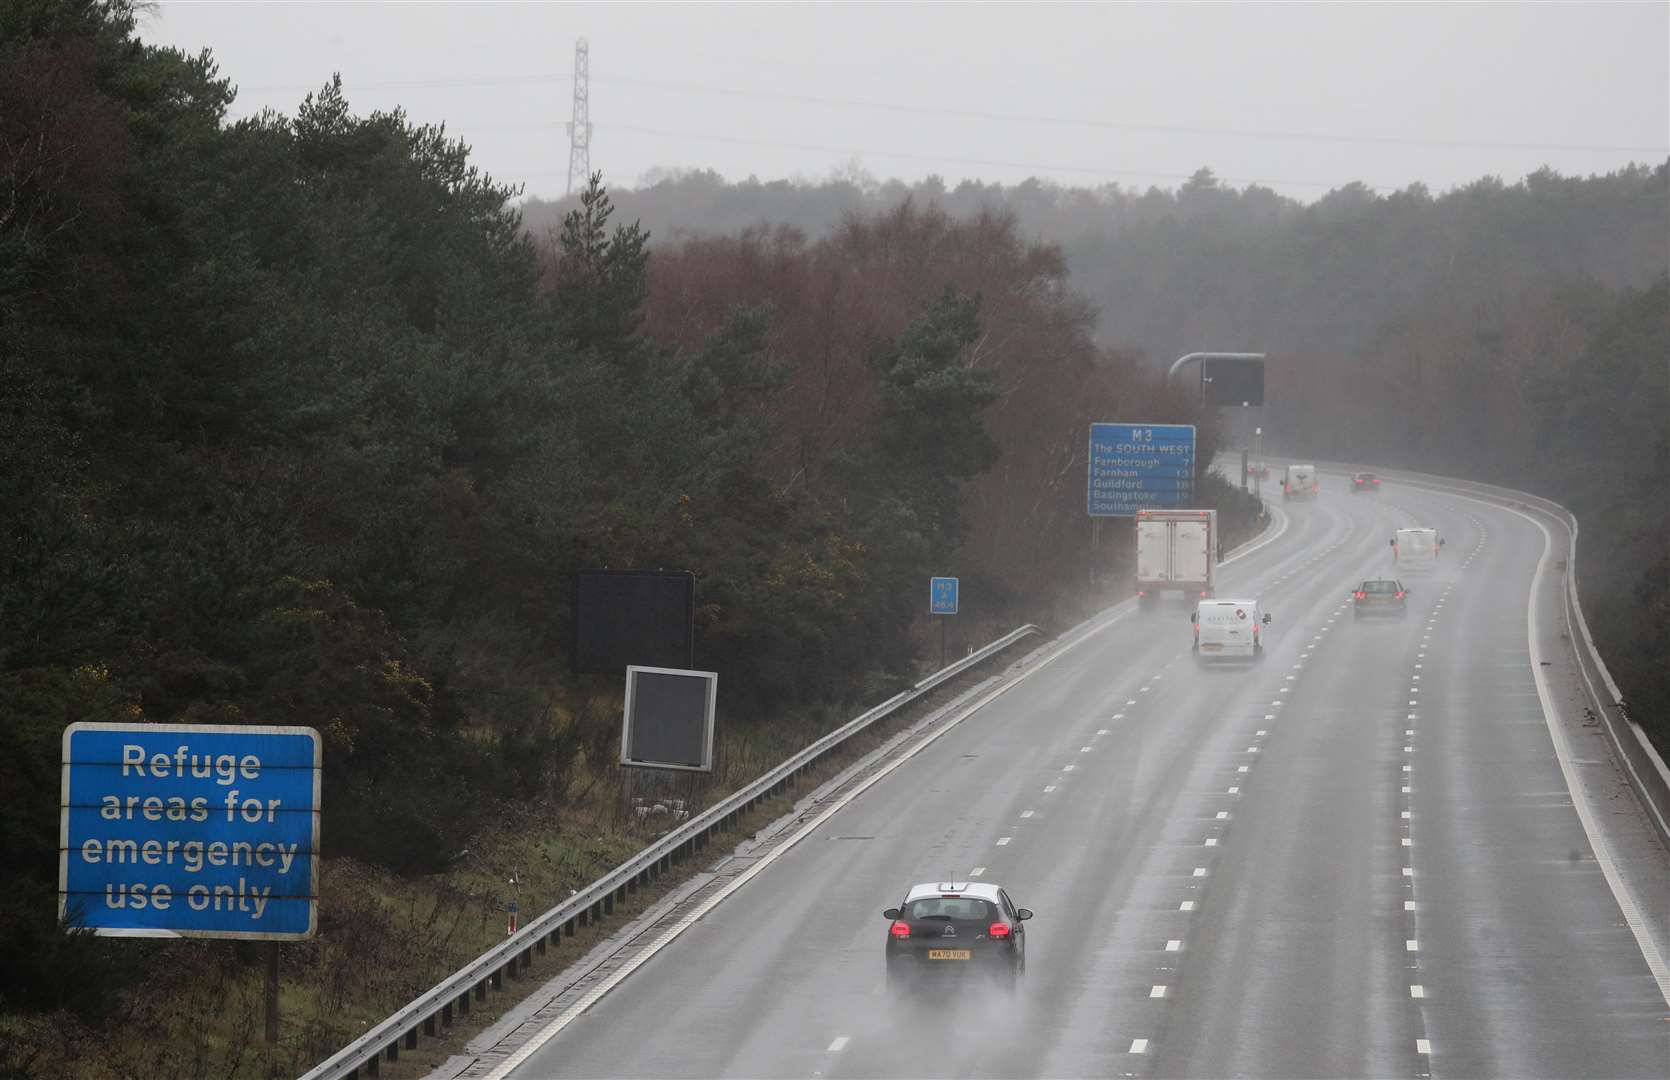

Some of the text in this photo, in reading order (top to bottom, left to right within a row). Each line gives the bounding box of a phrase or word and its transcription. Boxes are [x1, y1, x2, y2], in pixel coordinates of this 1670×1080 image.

[1132, 429, 1152, 442] M3
[1094, 444, 1191, 455] The SOUTH WEST
[1095, 457, 1160, 469] Farnborough
[1094, 469, 1138, 478] Farnham
[1093, 479, 1143, 489] Guildford
[1093, 490, 1157, 502] Basingstoke
[122, 745, 261, 786] Refuge
[100, 790, 281, 823] areas for
[81, 838, 298, 874] emergency
[105, 877, 271, 919] use only
